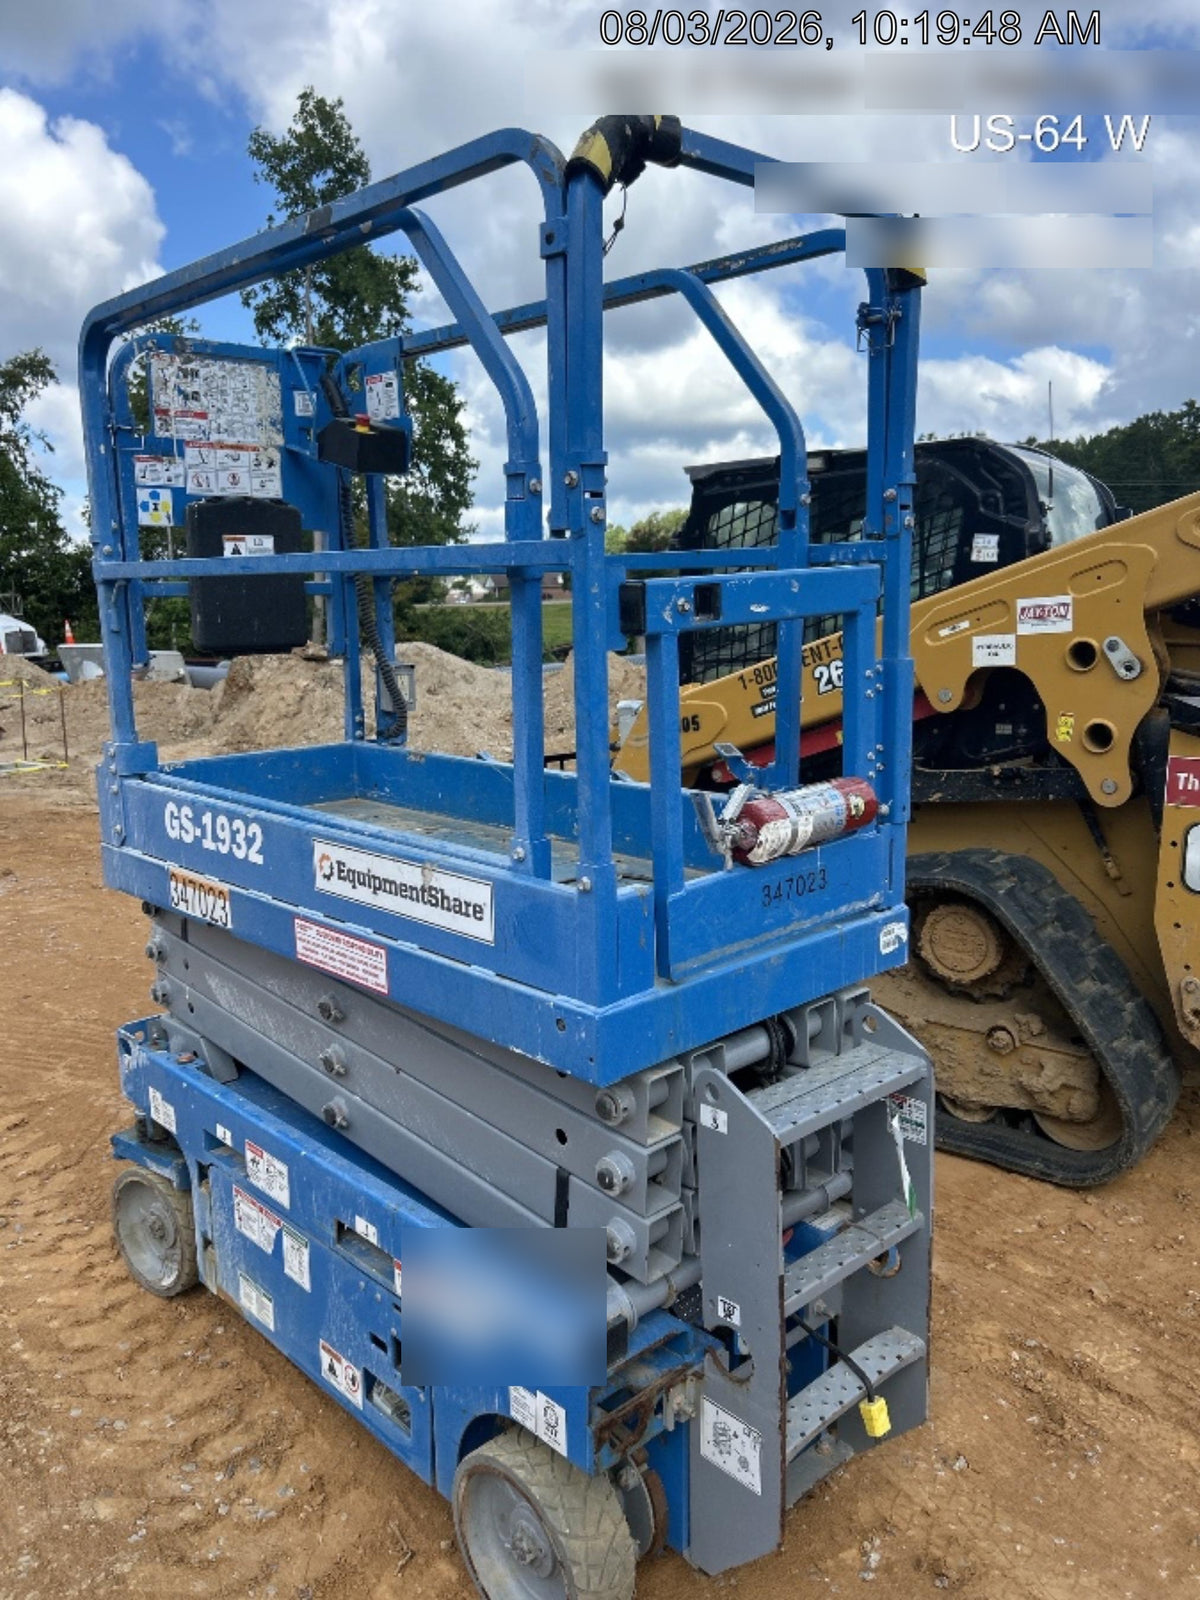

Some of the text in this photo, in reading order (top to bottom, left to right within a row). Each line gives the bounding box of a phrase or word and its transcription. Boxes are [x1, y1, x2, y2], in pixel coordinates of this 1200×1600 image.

[164, 801, 264, 865] GS-1932
[169, 872, 229, 928] 347023
[335, 859, 484, 922] EquipmentShare
[761, 868, 828, 908] 347023
